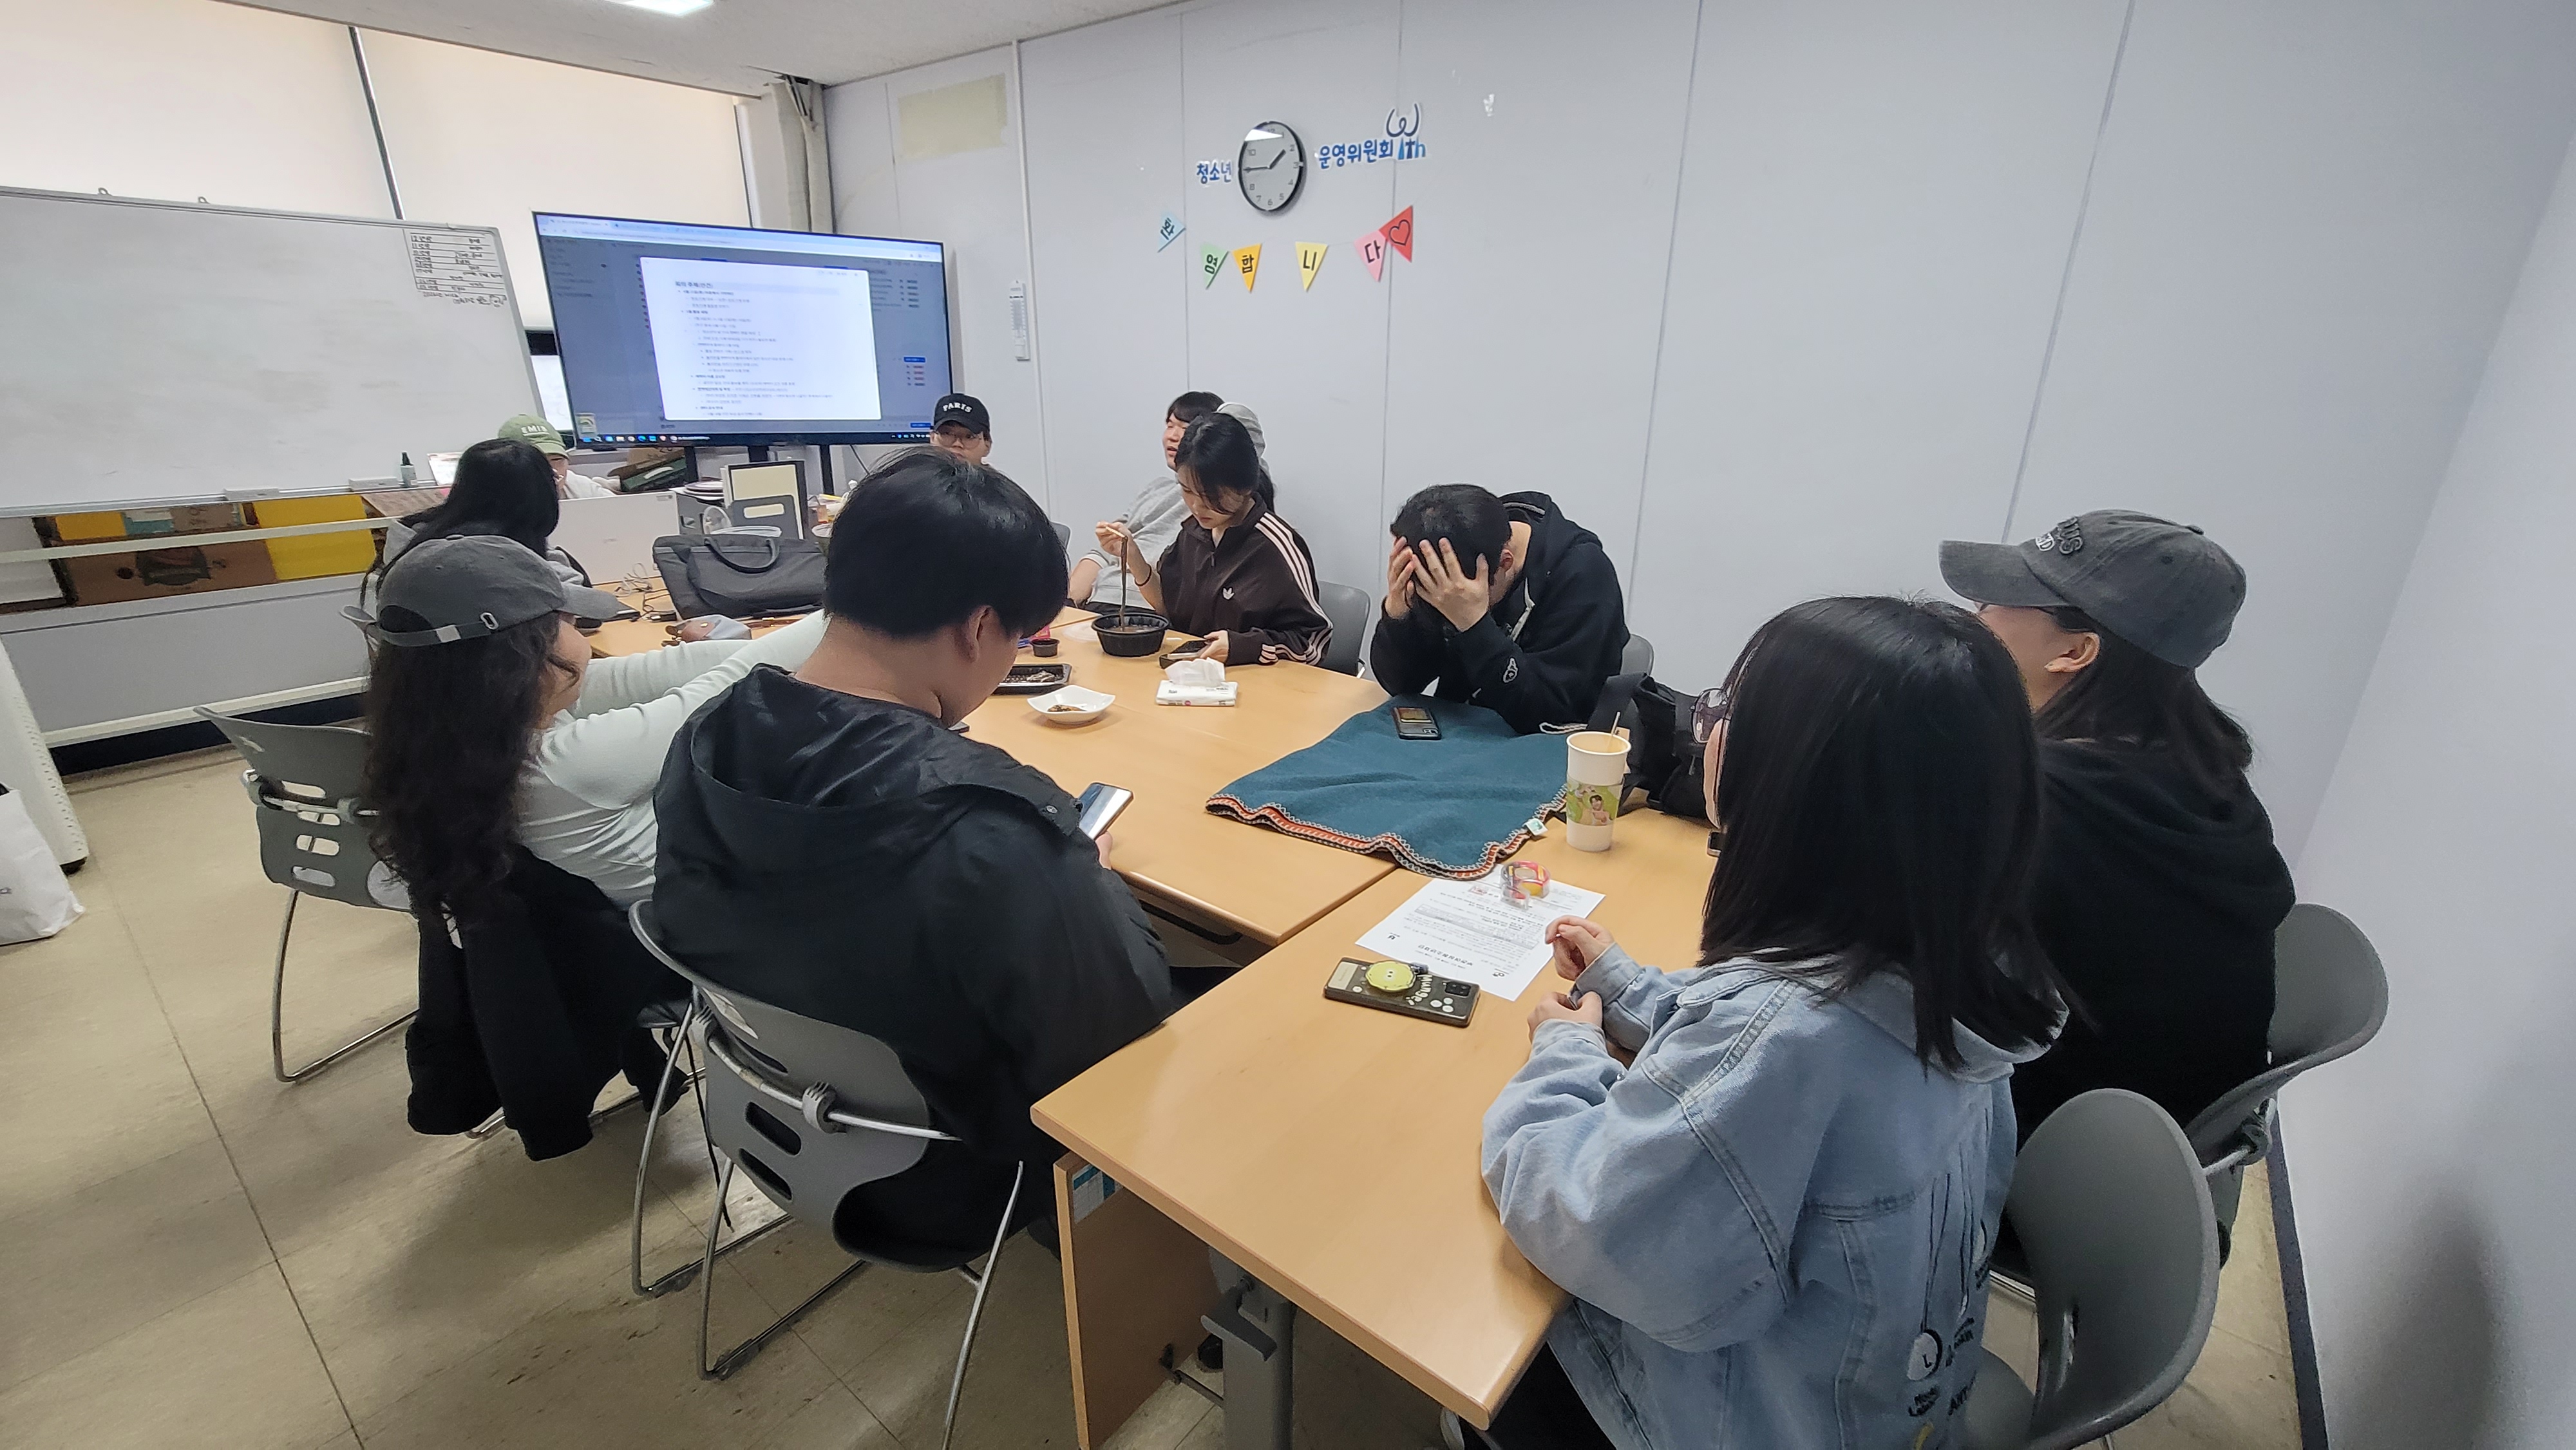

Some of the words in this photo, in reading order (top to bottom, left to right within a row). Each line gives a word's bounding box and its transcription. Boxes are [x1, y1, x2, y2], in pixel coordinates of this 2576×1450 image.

[1319, 139, 1394, 169] 운영위원회
[1197, 162, 1231, 184] 청소년
[942, 402, 972, 413] PARIS
[520, 426, 547, 434] EMIS
